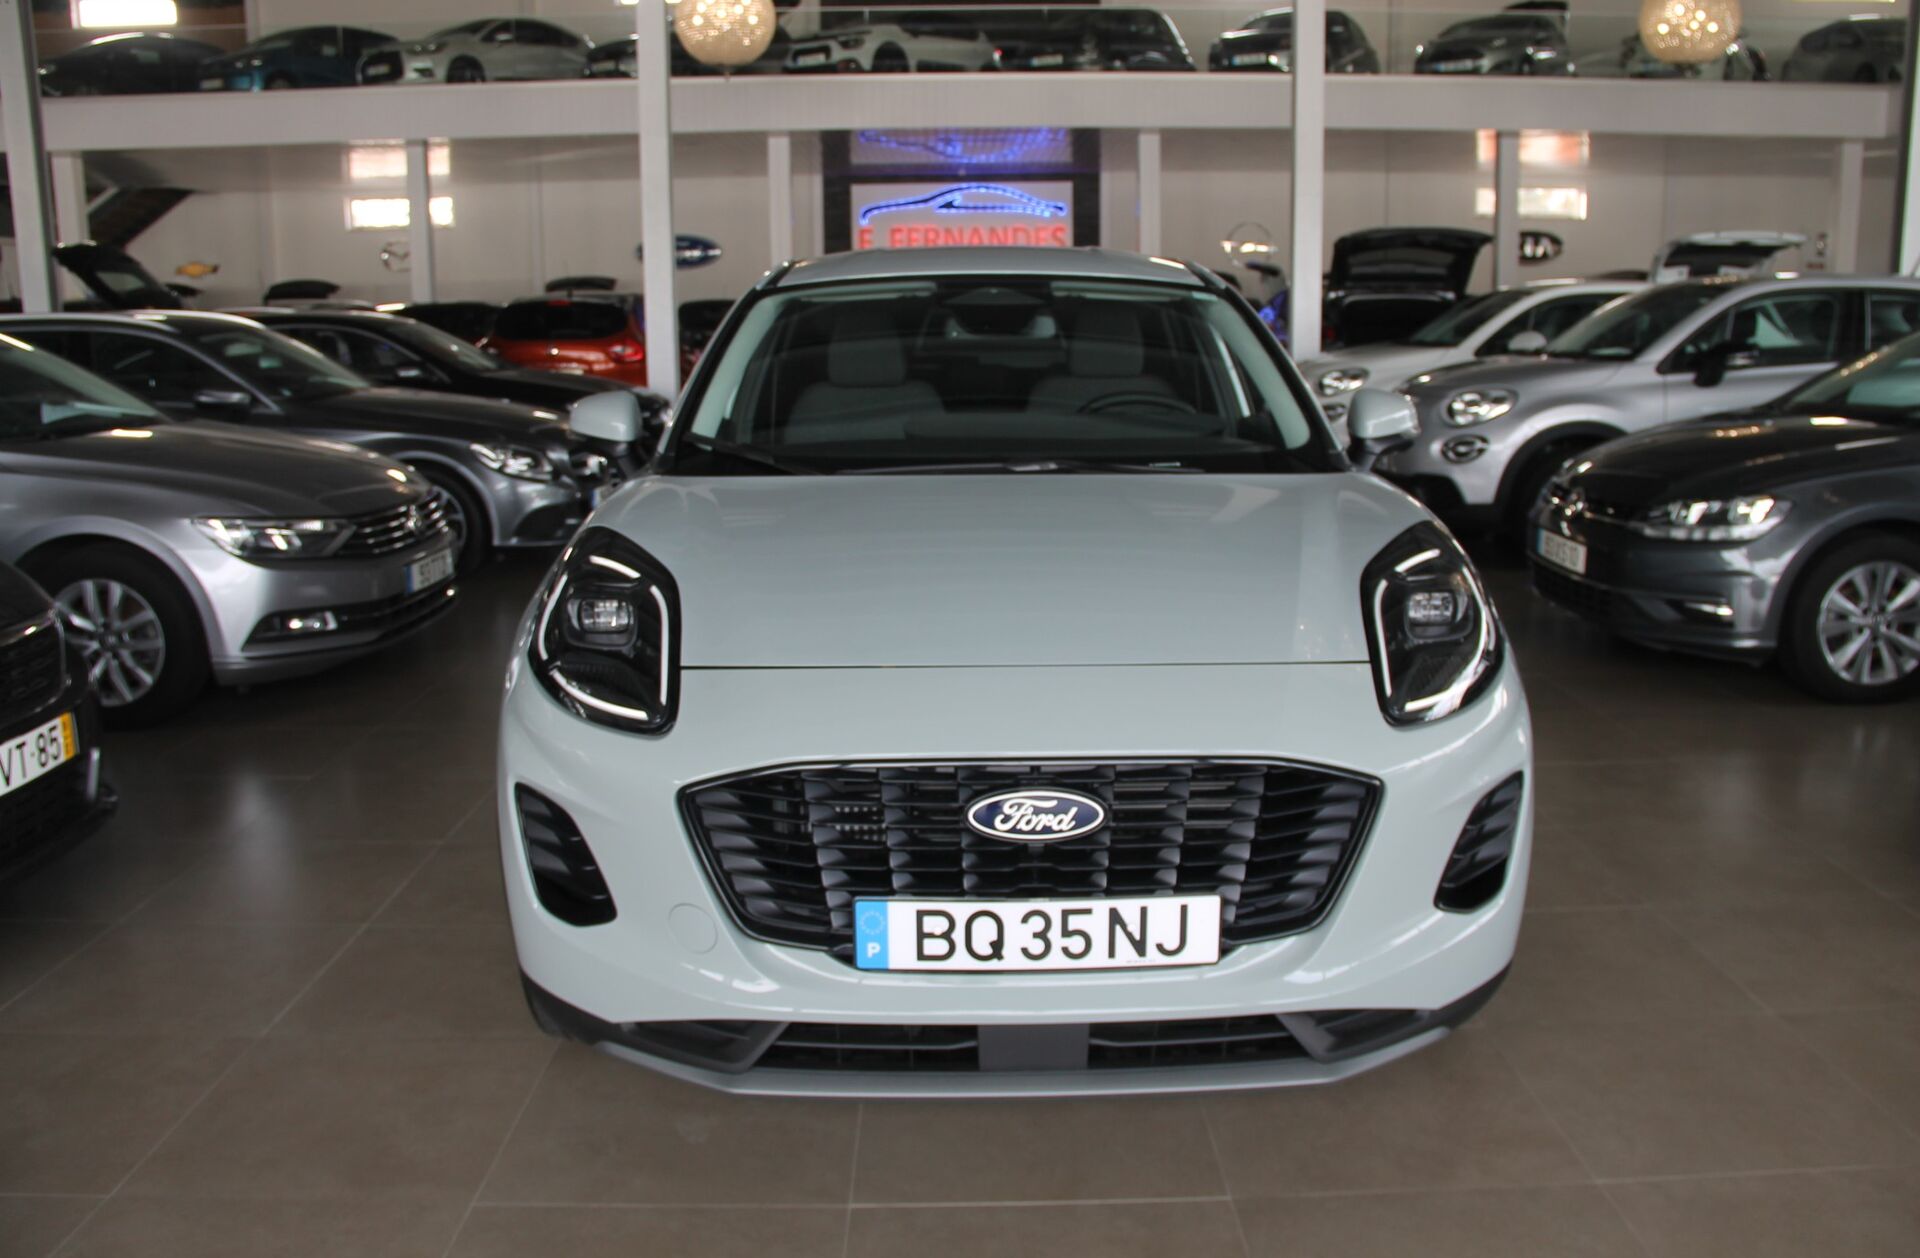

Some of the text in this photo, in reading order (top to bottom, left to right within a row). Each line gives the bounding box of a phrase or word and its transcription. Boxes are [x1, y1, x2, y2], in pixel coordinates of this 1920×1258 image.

[889, 225, 1067, 249] FERNANDES
[994, 798, 1078, 831] Ford
[867, 904, 1188, 961] P BQ 35 NJ
